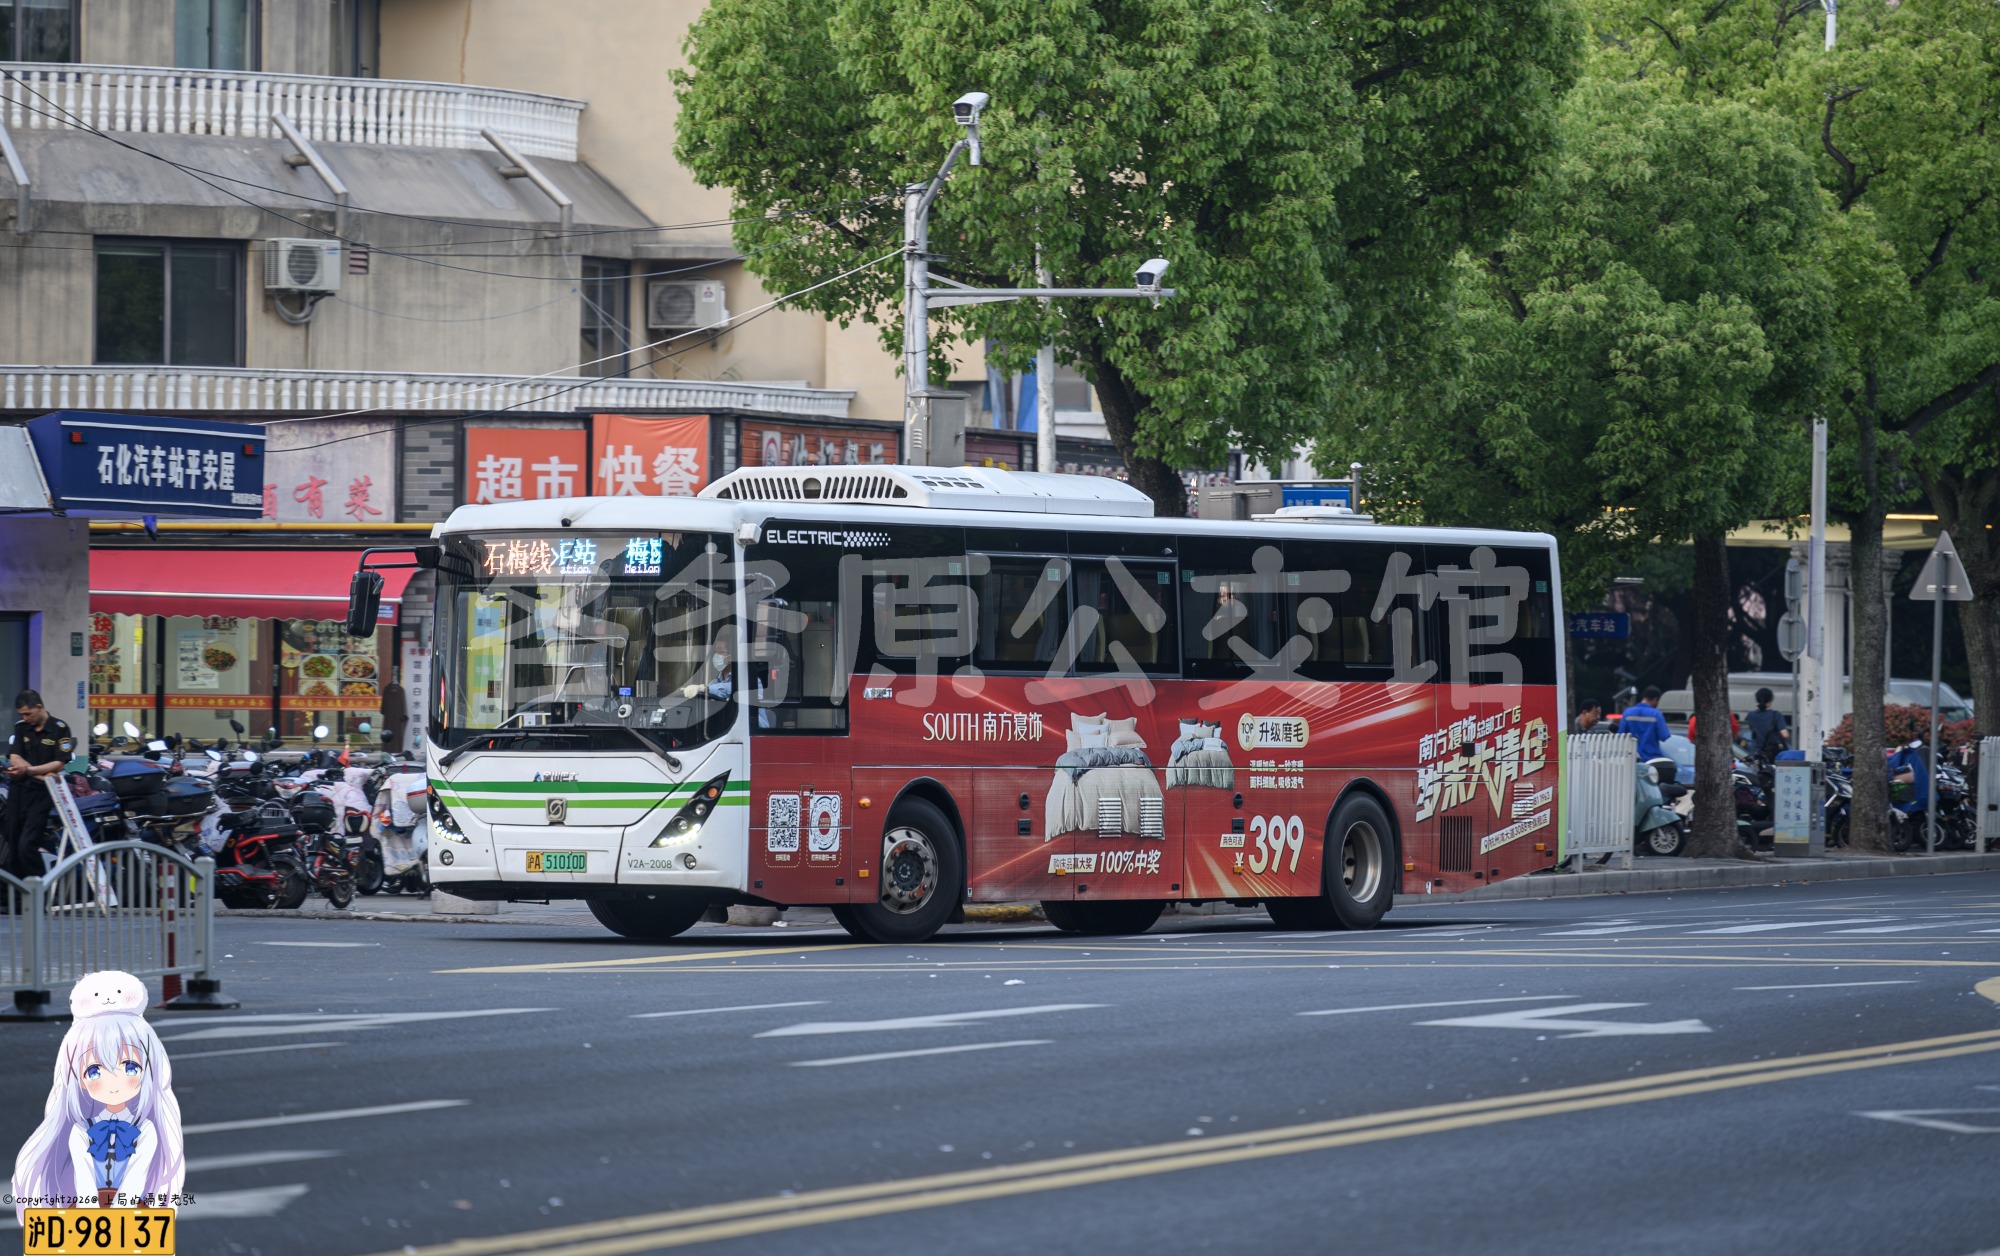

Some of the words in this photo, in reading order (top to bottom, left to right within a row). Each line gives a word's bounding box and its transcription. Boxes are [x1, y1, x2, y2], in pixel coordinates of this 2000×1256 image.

[97, 443, 236, 491] 石化汽车站平安屋
[476, 453, 580, 504] 超市
[598, 444, 701, 498] 快餐
[766, 529, 842, 546] ELECTRIC
[483, 539, 552, 576] 石梅线
[923, 712, 979, 741] SOUTH
[983, 711, 1043, 742] 南方寝饰
[1241, 722, 1254, 735] TOP
[1259, 721, 1304, 743] 升级磨毛
[1419, 714, 1477, 764] 南方寝饰
[1476, 704, 1522, 740] 总部工厂店
[627, 859, 673, 869] V2A-2008
[1099, 849, 1162, 875] 100%中奖
